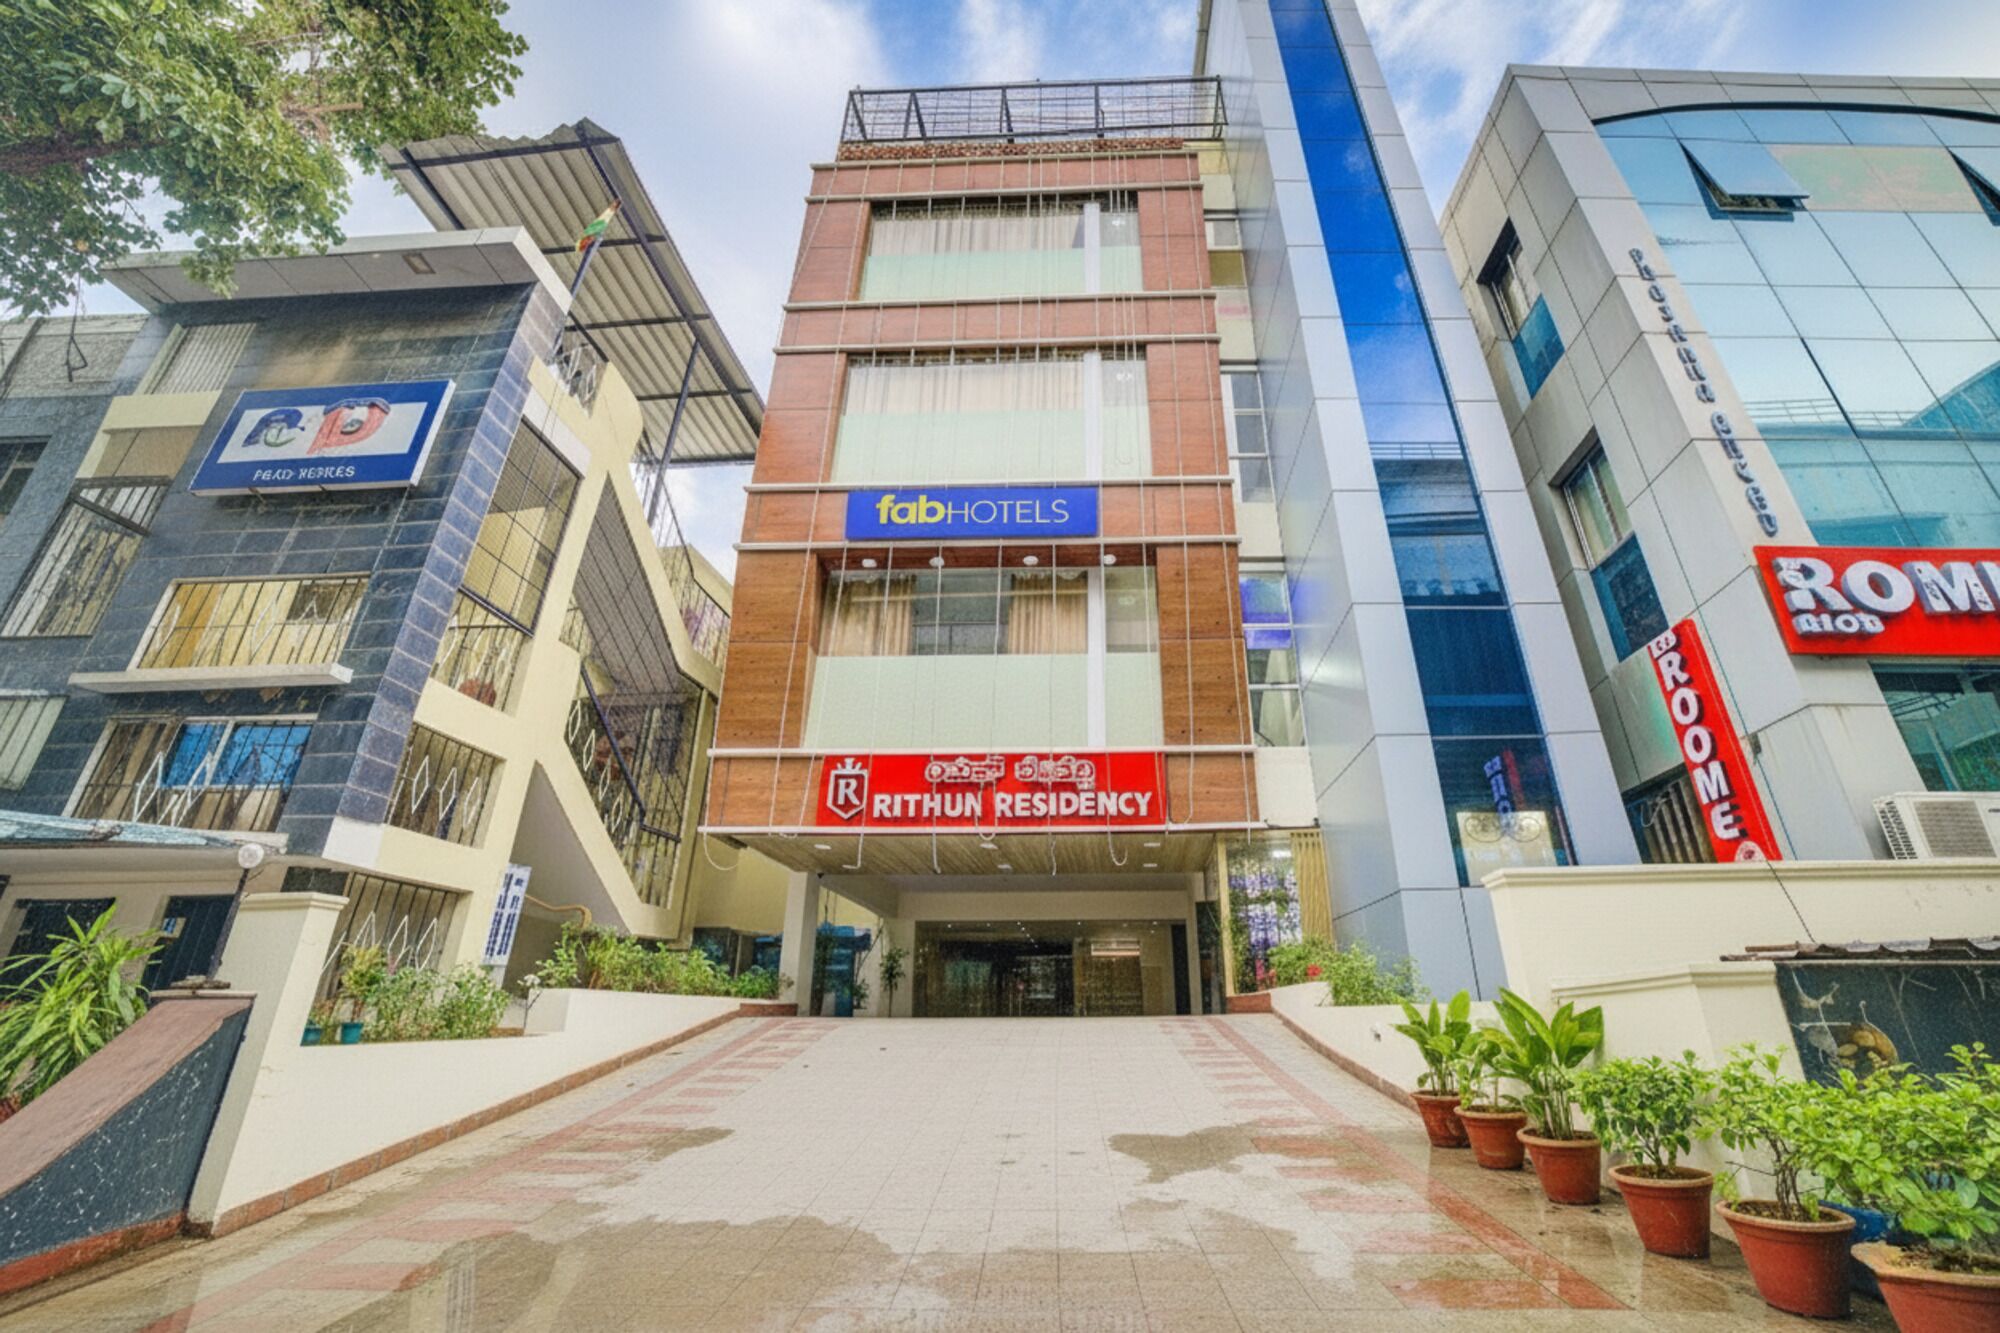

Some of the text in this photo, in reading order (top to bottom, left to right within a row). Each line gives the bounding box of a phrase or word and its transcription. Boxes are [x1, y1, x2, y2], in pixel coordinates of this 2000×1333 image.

[876, 494, 1070, 524] fabHOTELS
[837, 779, 858, 806] R
[872, 791, 1153, 819] RITHUN RESIDENCY
